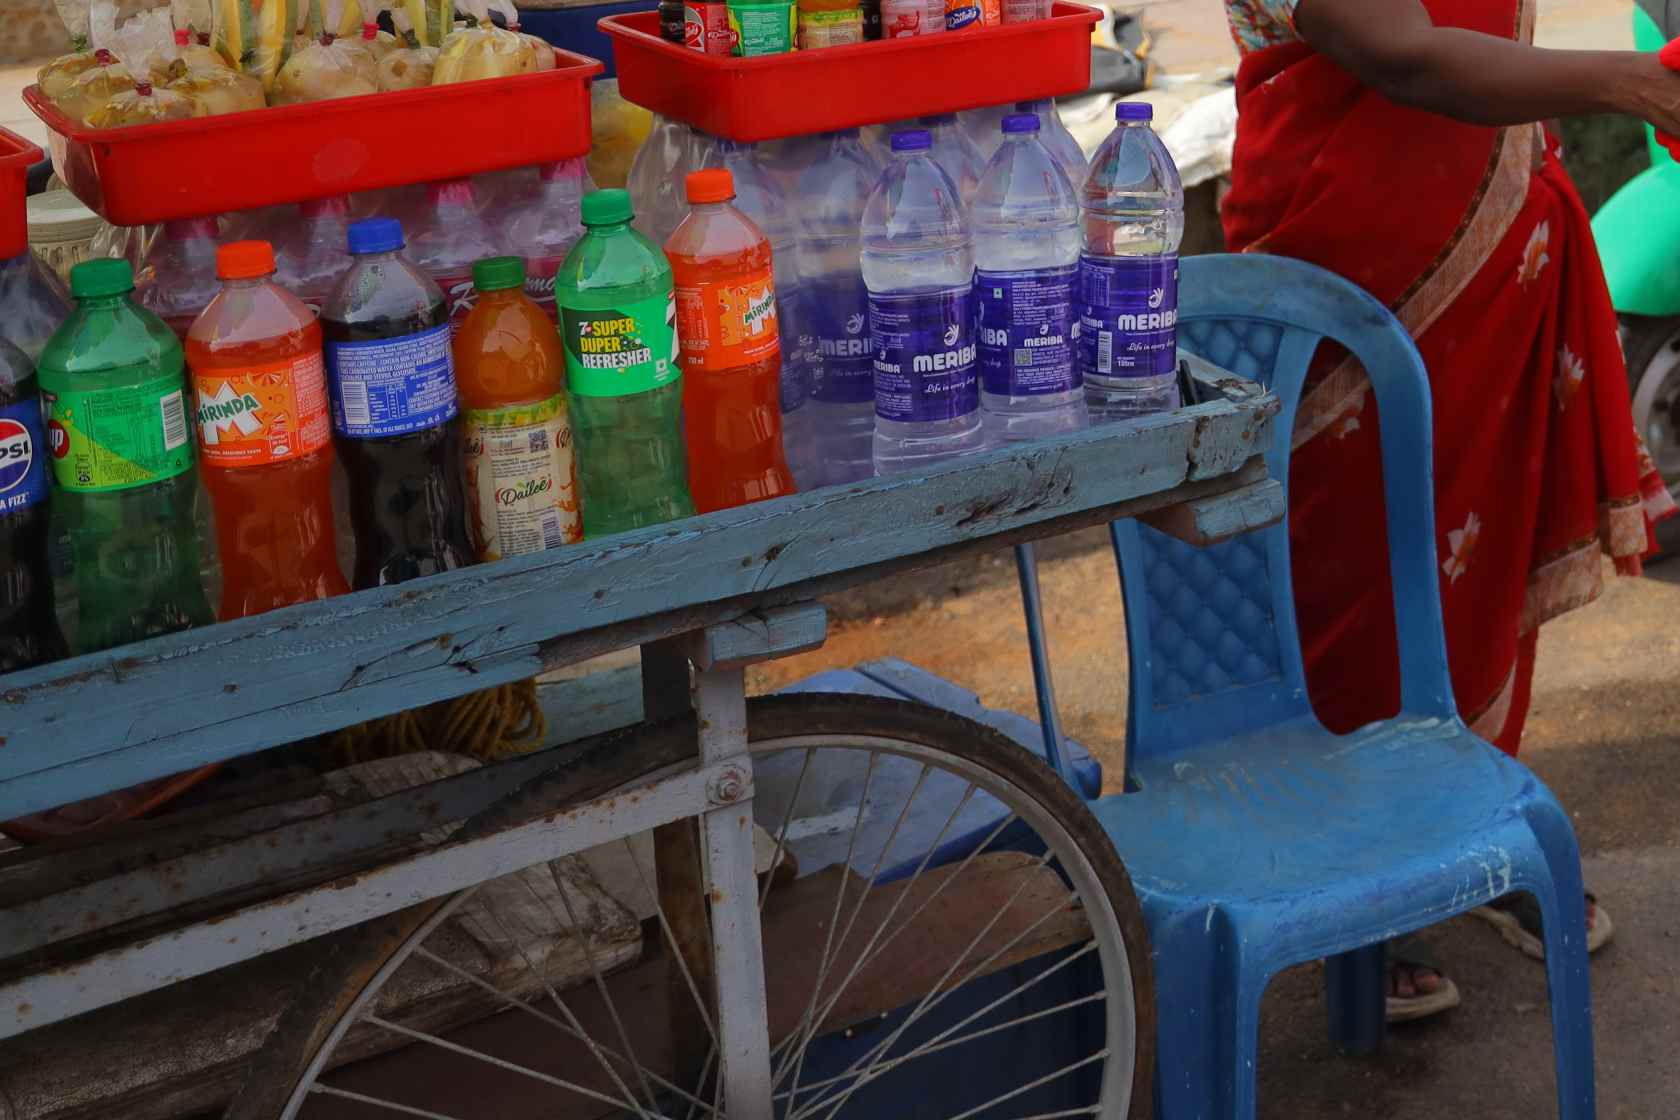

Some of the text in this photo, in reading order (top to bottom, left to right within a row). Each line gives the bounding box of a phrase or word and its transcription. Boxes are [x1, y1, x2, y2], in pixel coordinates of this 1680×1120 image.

[592, 318, 634, 337] SUPER
[580, 336, 621, 353] DUPER
[582, 348, 652, 369] REFRESHER
[913, 344, 977, 373] MERIBA
